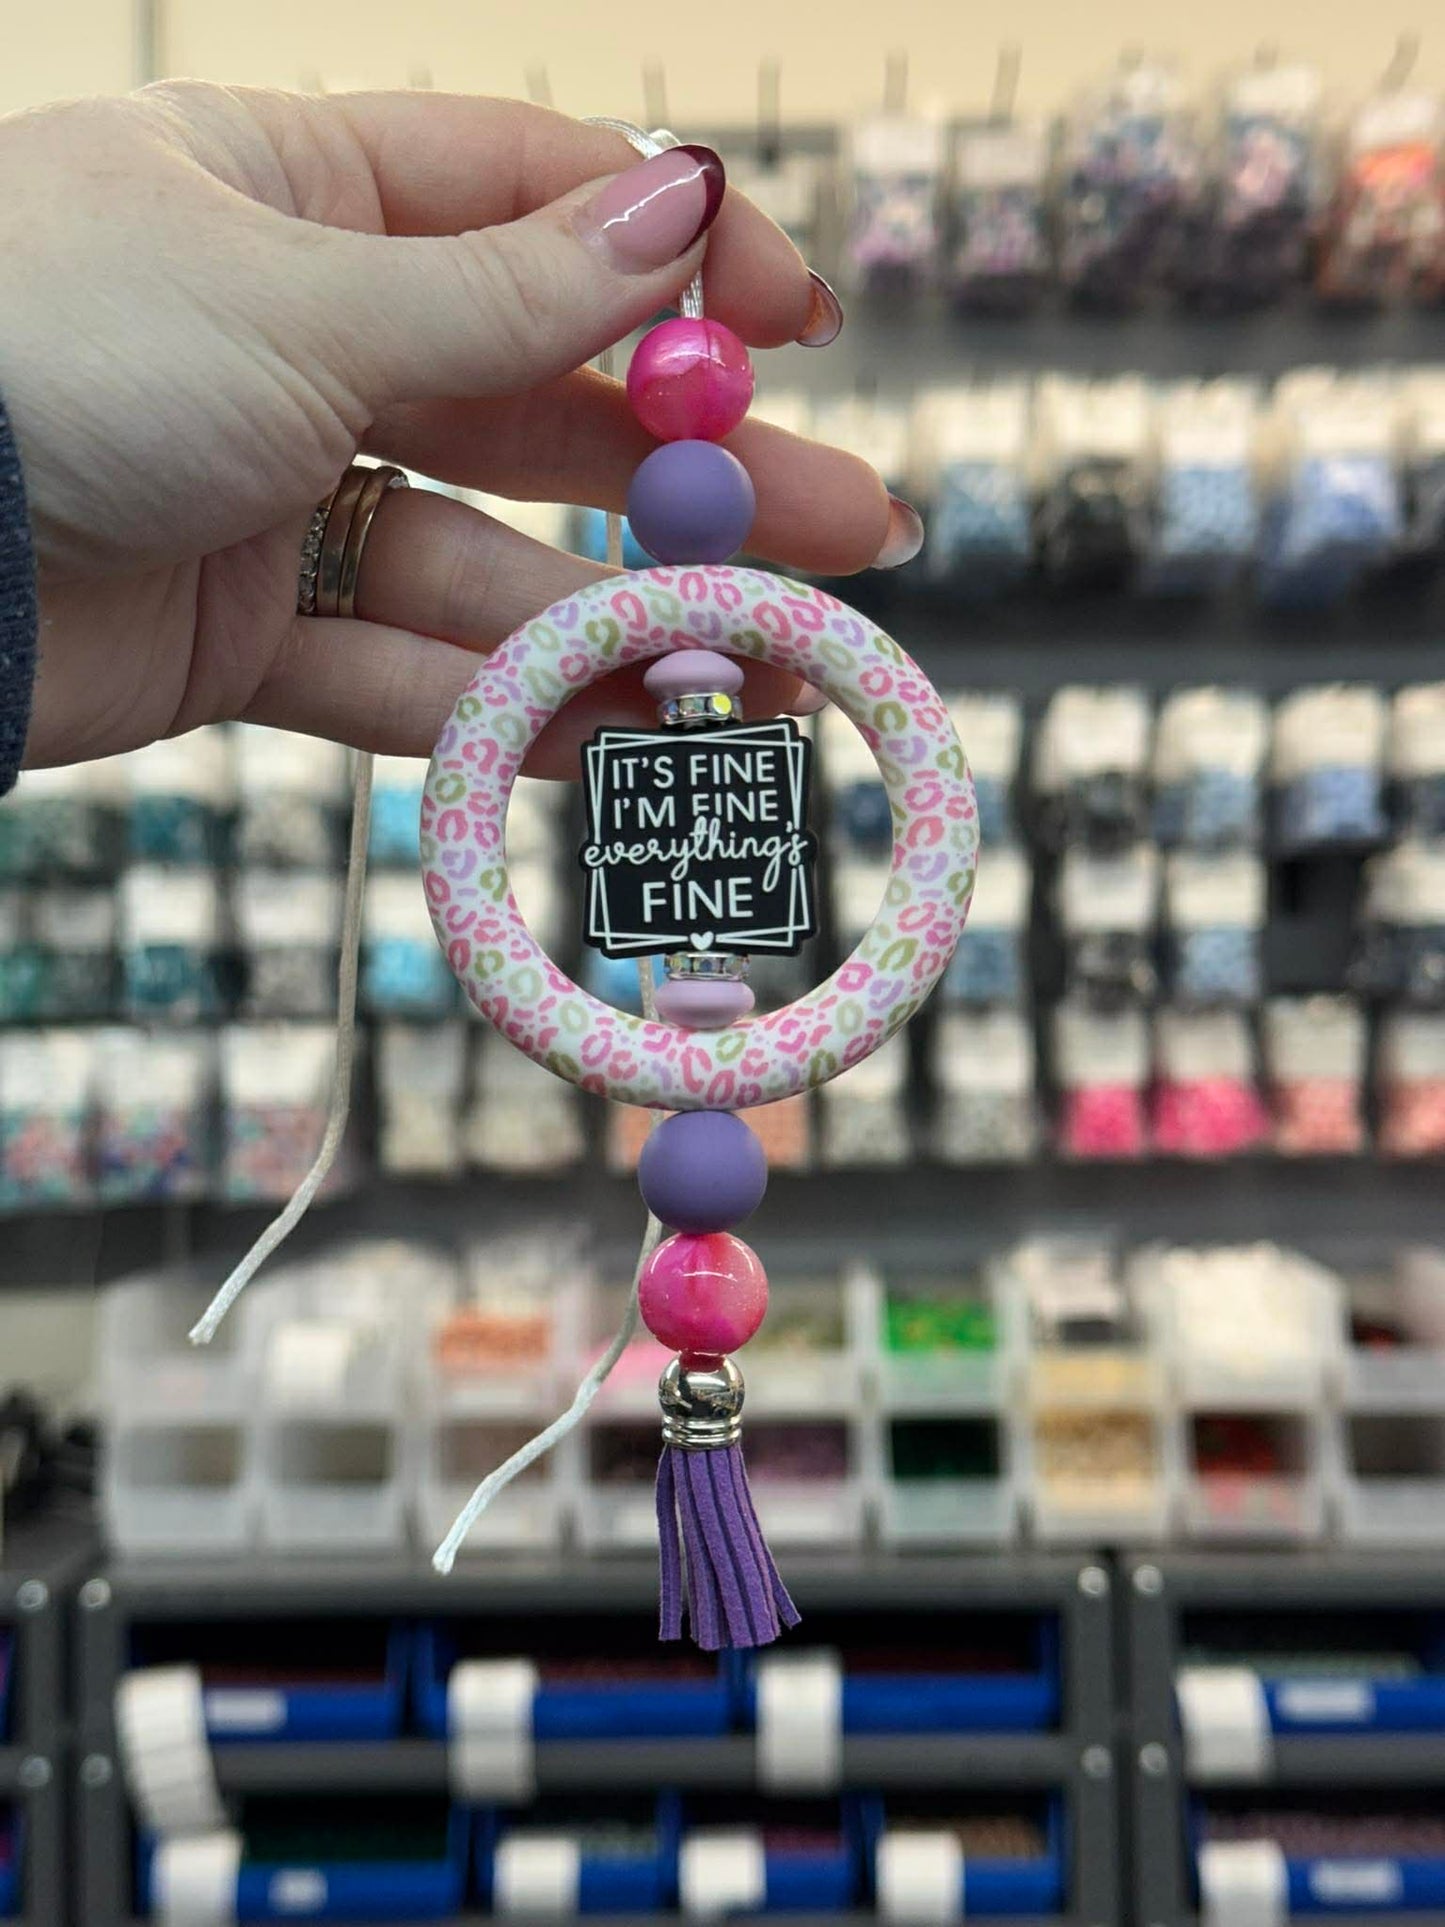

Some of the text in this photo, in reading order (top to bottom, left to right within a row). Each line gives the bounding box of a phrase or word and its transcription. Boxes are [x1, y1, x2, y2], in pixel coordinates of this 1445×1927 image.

[612, 751, 776, 790] IT'S FINE
[614, 789, 779, 830] I'M FINE
[584, 815, 809, 893] everything's
[642, 877, 754, 923] FINE
